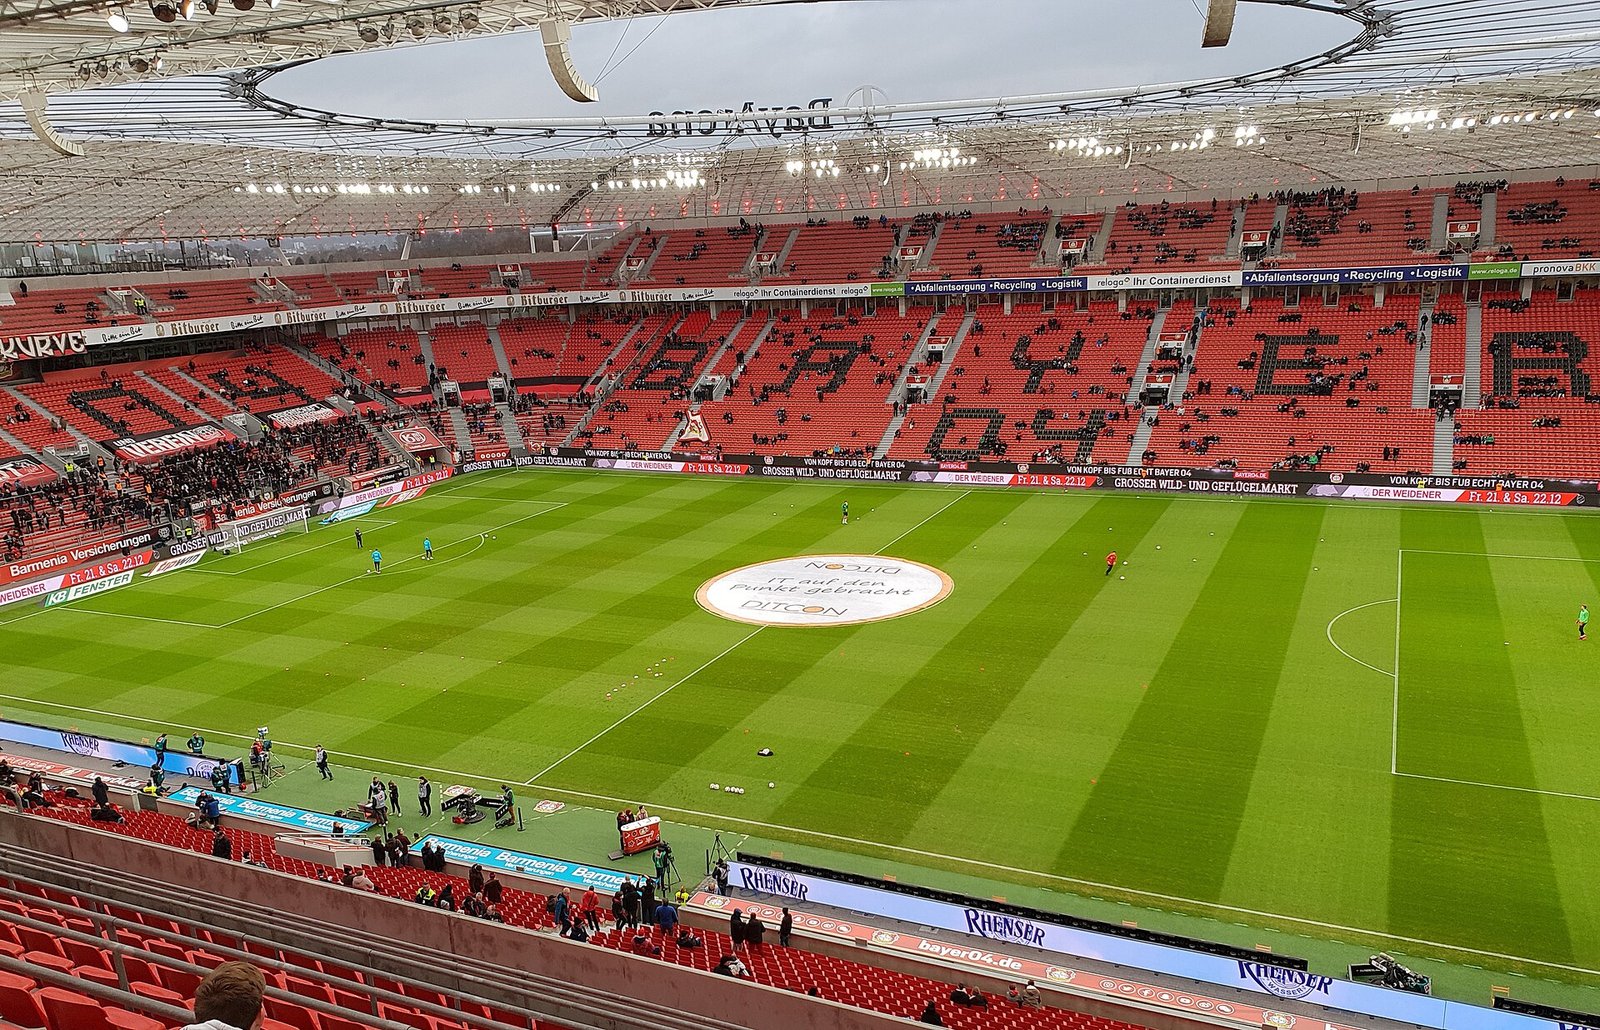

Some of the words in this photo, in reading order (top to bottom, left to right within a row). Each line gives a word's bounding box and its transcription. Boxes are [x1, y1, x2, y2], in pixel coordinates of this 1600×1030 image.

[1133, 276, 1146, 286] Ihr
[1149, 274, 1232, 286] Containerdienst
[1250, 272, 1340, 284] Abfallentsorgung
[1350, 269, 1404, 280] Recycling
[1416, 267, 1462, 278] Logistik
[761, 288, 772, 297] Ihr
[774, 286, 836, 297] Containerdienst
[914, 282, 986, 293] Abfallentsorgung
[994, 281, 1037, 292] Recycling
[1046, 280, 1082, 288] Logistik
[521, 294, 568, 306] Bitburger
[631, 292, 672, 302] Bitburger
[395, 302, 446, 314] Bitburger
[286, 310, 327, 324] Bitburger
[170, 322, 220, 336] Bitburger
[120, 430, 201, 457] VEREIN
[463, 459, 492, 473] GROSSER
[493, 458, 514, 468] WILD-
[517, 456, 534, 466] UND
[534, 456, 587, 467] GEFLÜGELMARKT
[631, 461, 642, 469] DER
[643, 462, 673, 470] WEIDENER
[708, 465, 713, 473] &
[724, 465, 742, 474] 22.12
[804, 458, 816, 466] VON
[816, 458, 834, 466] KOPF
[834, 458, 845, 467] BIS
[876, 460, 896, 469] BAYER
[896, 461, 906, 469] 04
[435, 470, 449, 481] 22.12
[762, 466, 796, 476] GROSSER
[796, 468, 817, 478] WILD-
[818, 468, 835, 478] UND
[836, 468, 902, 480] GEFLÜGELMARKT
[954, 474, 970, 482] DER
[970, 474, 1004, 483] WEIDENER
[1066, 466, 1082, 474] VON
[1082, 466, 1103, 474] KOPF
[1104, 467, 1116, 475] BIS
[1154, 468, 1180, 477] BAYER
[1180, 469, 1192, 477] 04
[1018, 476, 1028, 485] Fr.
[1030, 476, 1041, 486] 21.
[1042, 477, 1050, 485] &
[1050, 478, 1063, 486] Sa.
[1066, 477, 1086, 486] 22.12
[1114, 478, 1158, 489] GROSSER
[1158, 480, 1186, 490] WILD-
[1188, 480, 1210, 491] UND
[1212, 480, 1298, 494] GEFLÜGELMARKT
[1390, 476, 1408, 485] VON
[1409, 476, 1434, 486] KOPF
[1435, 477, 1451, 487] BIS
[1472, 478, 1496, 488] ECHT
[1530, 480, 1544, 490] 04
[356, 494, 368, 502] DER
[1372, 488, 1391, 498] DER
[1392, 488, 1442, 499] WEIDENER
[1468, 492, 1484, 502] Fr.
[1486, 492, 1501, 502] 21.
[1503, 493, 1512, 502] &
[1514, 492, 1530, 504] Sa.
[1533, 493, 1562, 504] 22.12
[214, 506, 256, 523] Baenia
[170, 537, 206, 556] GROSSER
[208, 531, 232, 545] WILD-
[10, 555, 68, 578] Barmenia
[70, 533, 152, 561] Versicherungen
[69, 574, 84, 586] Fr.
[84, 570, 98, 581] 21.
[99, 565, 106, 576] &
[108, 561, 121, 573] Sa.
[122, 554, 144, 571] 22.12
[804, 561, 902, 575] DITCON
[798, 577, 840, 586] auf
[842, 578, 888, 587] den
[48, 590, 67, 606] KB
[73, 574, 130, 597] FENSTER
[730, 584, 798, 594] Punkt
[804, 586, 915, 596] gebracht
[740, 600, 848, 616] DITCON
[60, 732, 100, 752] RHENSER
[237, 801, 297, 818] Barmenia
[298, 813, 360, 830] Barmnia
[423, 838, 492, 858] Barmenia
[495, 852, 568, 872] Barmenia
[740, 868, 808, 901] RHENSER
[964, 908, 1046, 947] RHENSER
[918, 940, 1022, 970] bayer04.de
[1238, 960, 1332, 996] RHENSER
[1268, 981, 1302, 996] WASSER
